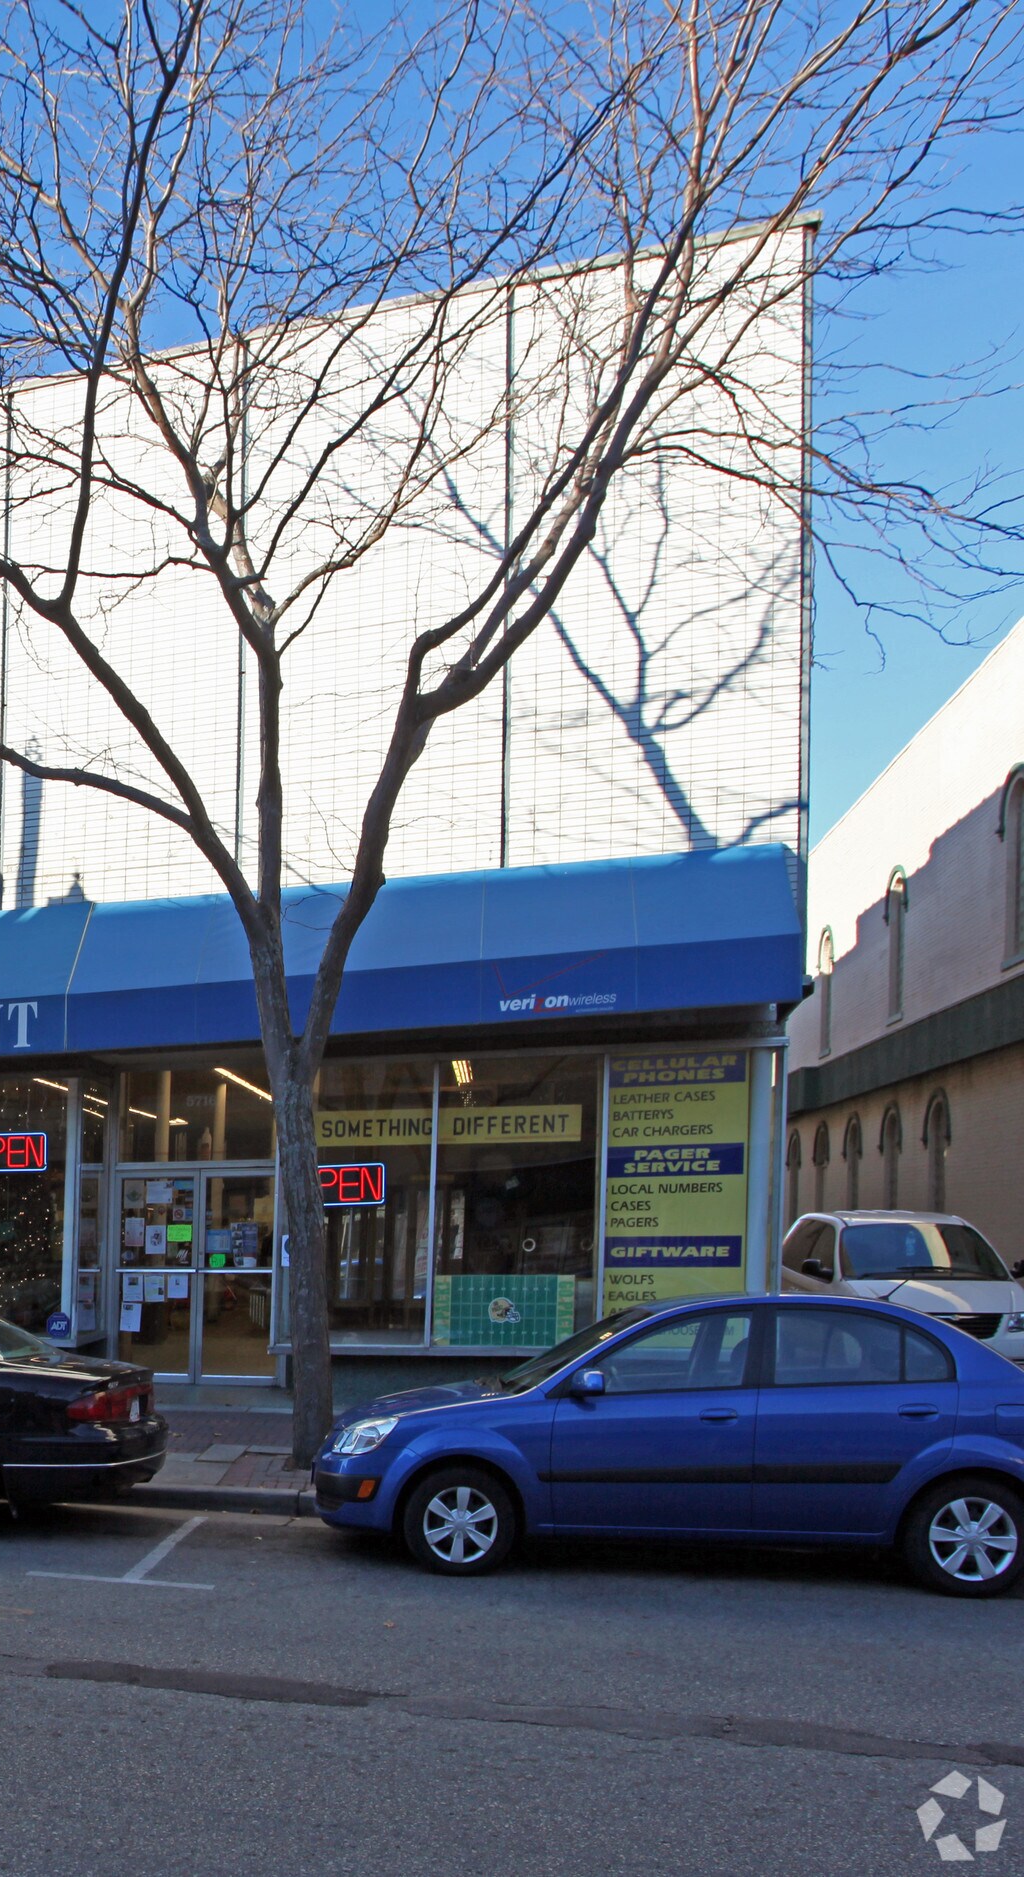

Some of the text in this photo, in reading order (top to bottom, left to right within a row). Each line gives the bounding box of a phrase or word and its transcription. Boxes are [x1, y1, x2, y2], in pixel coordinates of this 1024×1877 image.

[611, 1055, 737, 1071] CELLULAR
[623, 1068, 725, 1083] PHONES
[613, 1090, 716, 1105] LEATHER CASES
[613, 1109, 674, 1121] BATTERYS
[322, 1114, 570, 1138] SOMETHING DIFFERENT
[612, 1124, 713, 1138] CAR CHARGERS
[634, 1148, 711, 1160] PAGER
[623, 1160, 720, 1174] SERVICE
[317, 1166, 382, 1202] PEN
[611, 1182, 723, 1195] LOCAL NUMBERS
[610, 1201, 651, 1212] CASES
[610, 1217, 659, 1228] PAGERS
[610, 1246, 731, 1258] GIFTWARE
[609, 1274, 655, 1285] WOLFS
[608, 1290, 657, 1301] EAGLES
[51, 1321, 67, 1331] ADT
